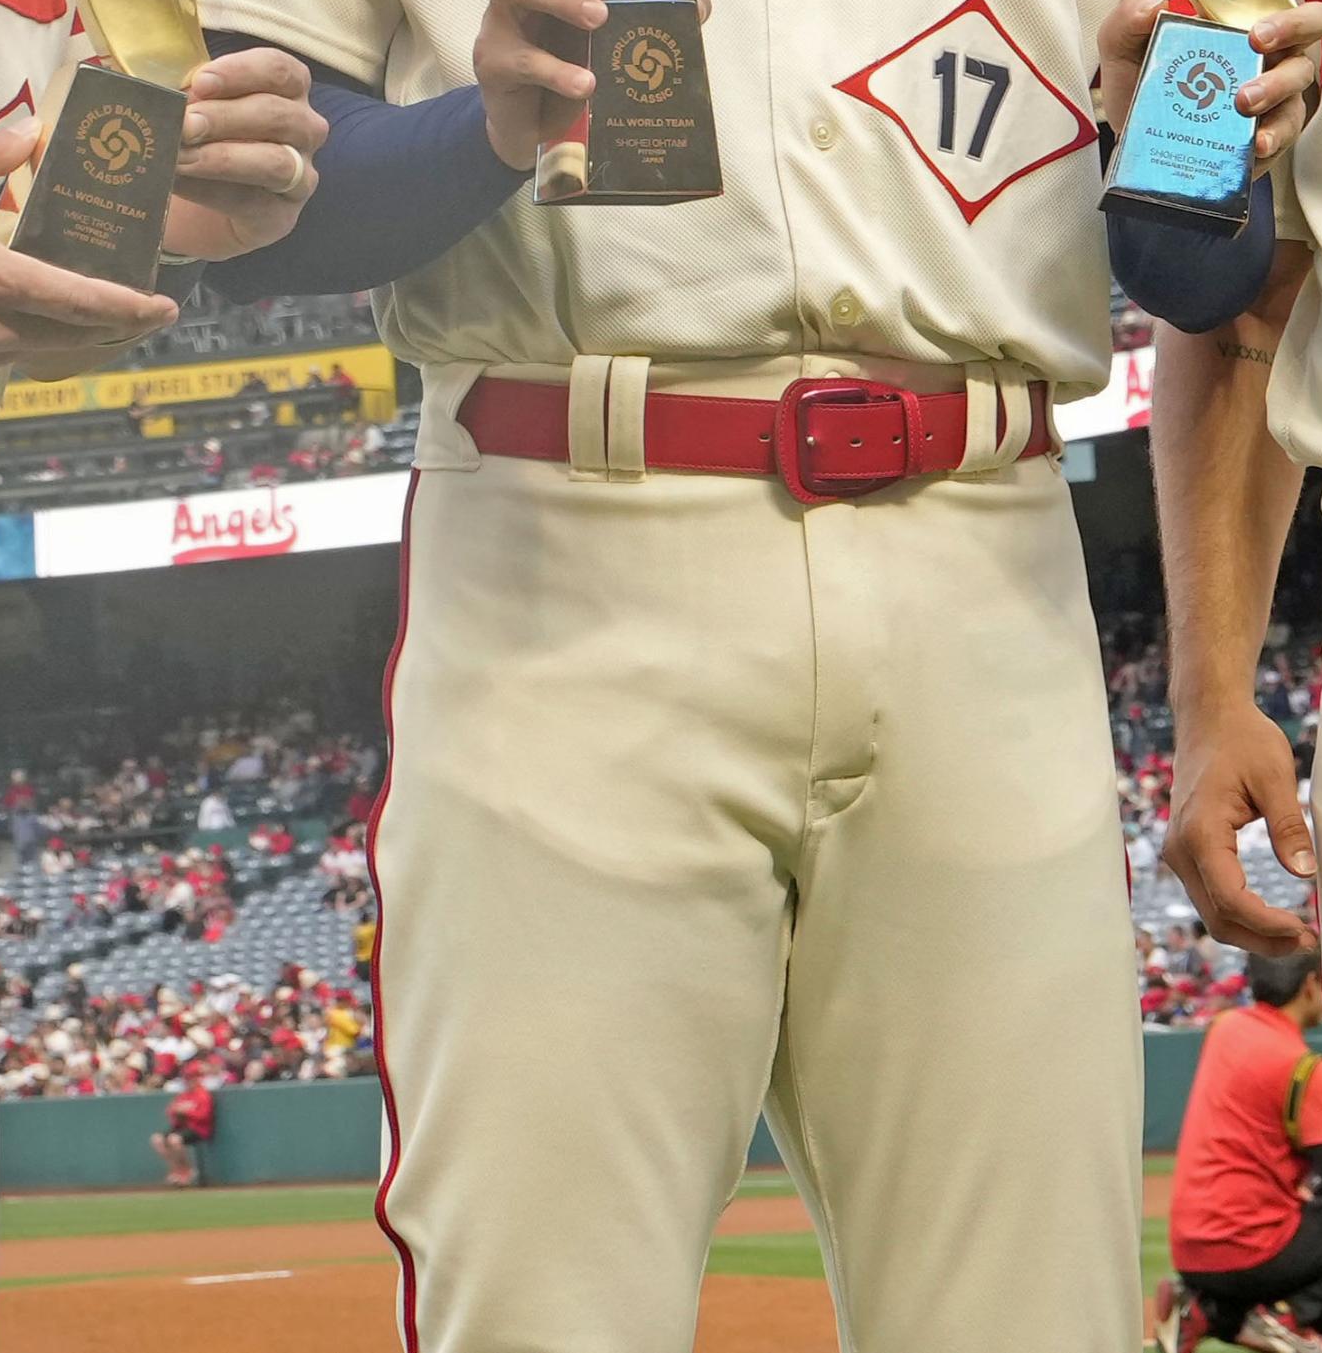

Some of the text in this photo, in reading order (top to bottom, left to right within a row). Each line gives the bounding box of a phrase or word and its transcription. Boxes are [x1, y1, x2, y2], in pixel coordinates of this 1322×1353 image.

[612, 27, 684, 72] WORLD BASEBALL
[1164, 49, 1240, 99] WORLD BASEBALL
[626, 87, 674, 104] CLASSIC
[932, 50, 1012, 159] 17
[606, 118, 695, 128] ALL WORLD TEAM
[1172, 103, 1221, 124] CLASSIC
[76, 104, 155, 160] WORLD BASEBALL
[615, 138, 651, 147] SHOHEI
[1145, 127, 1235, 153] ALL WORLD TEAM
[1150, 147, 1223, 170] SHOHEI OHTANI
[83, 160, 134, 186] CLASSIC
[53, 184, 147, 221] ALL WORLD TEAM
[64, 210, 125, 233] MIKE TROUT
[172, 486, 297, 565] Angels
